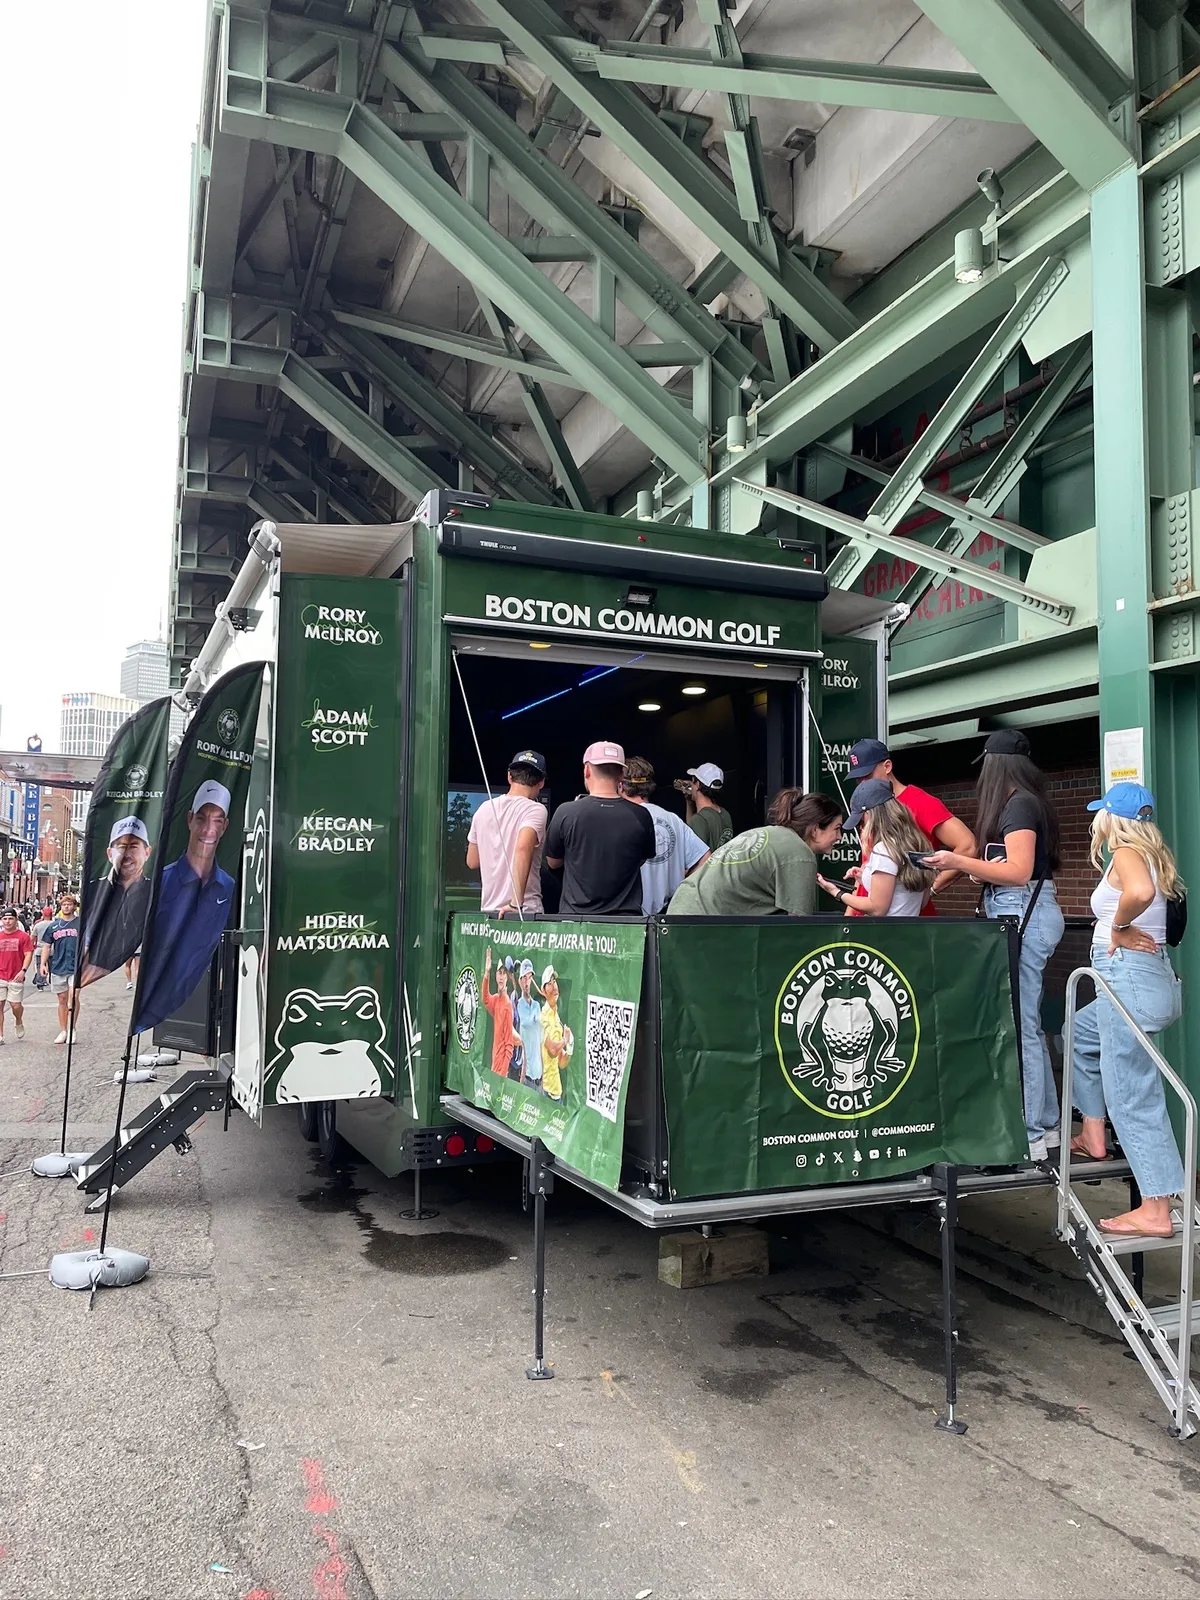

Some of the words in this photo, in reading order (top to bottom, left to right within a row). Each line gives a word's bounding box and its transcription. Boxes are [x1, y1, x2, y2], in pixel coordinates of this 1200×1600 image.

[318, 606, 367, 624] RORY
[485, 594, 591, 628] BOSTON
[597, 608, 713, 640] COMMON
[719, 620, 781, 646] GOLF
[304, 624, 380, 645] McILROY
[822, 658, 849, 671] ORY
[821, 674, 859, 689] ILROY
[313, 709, 369, 726] ADAM
[311, 728, 369, 746] SCOTT
[196, 739, 221, 755] RORY
[822, 743, 851, 756] DAM
[821, 760, 850, 772] COTT
[302, 816, 372, 832] KEEGAN
[298, 837, 376, 852] BRADLEY
[821, 849, 862, 862] ADLEY
[305, 914, 364, 929] HIDEKI
[53, 928, 78, 941] BOSTO
[276, 934, 390, 951] MATSUYAMA
[461, 922, 479, 936] WHICH
[493, 929, 523, 946] OMMON
[523, 931, 547, 948] GOLF
[548, 933, 579, 950] PLAYER
[594, 935, 617, 955] YOU?
[781, 951, 836, 1025] BOSTON
[843, 950, 912, 1021] COMMON
[826, 1089, 873, 1111] GOLF
[762, 1135, 797, 1147] BOSTON
[797, 1131, 837, 1144] COMMON
[837, 1129, 860, 1140] GOLF
[871, 1123, 936, 1138] @COMMONGOLF
